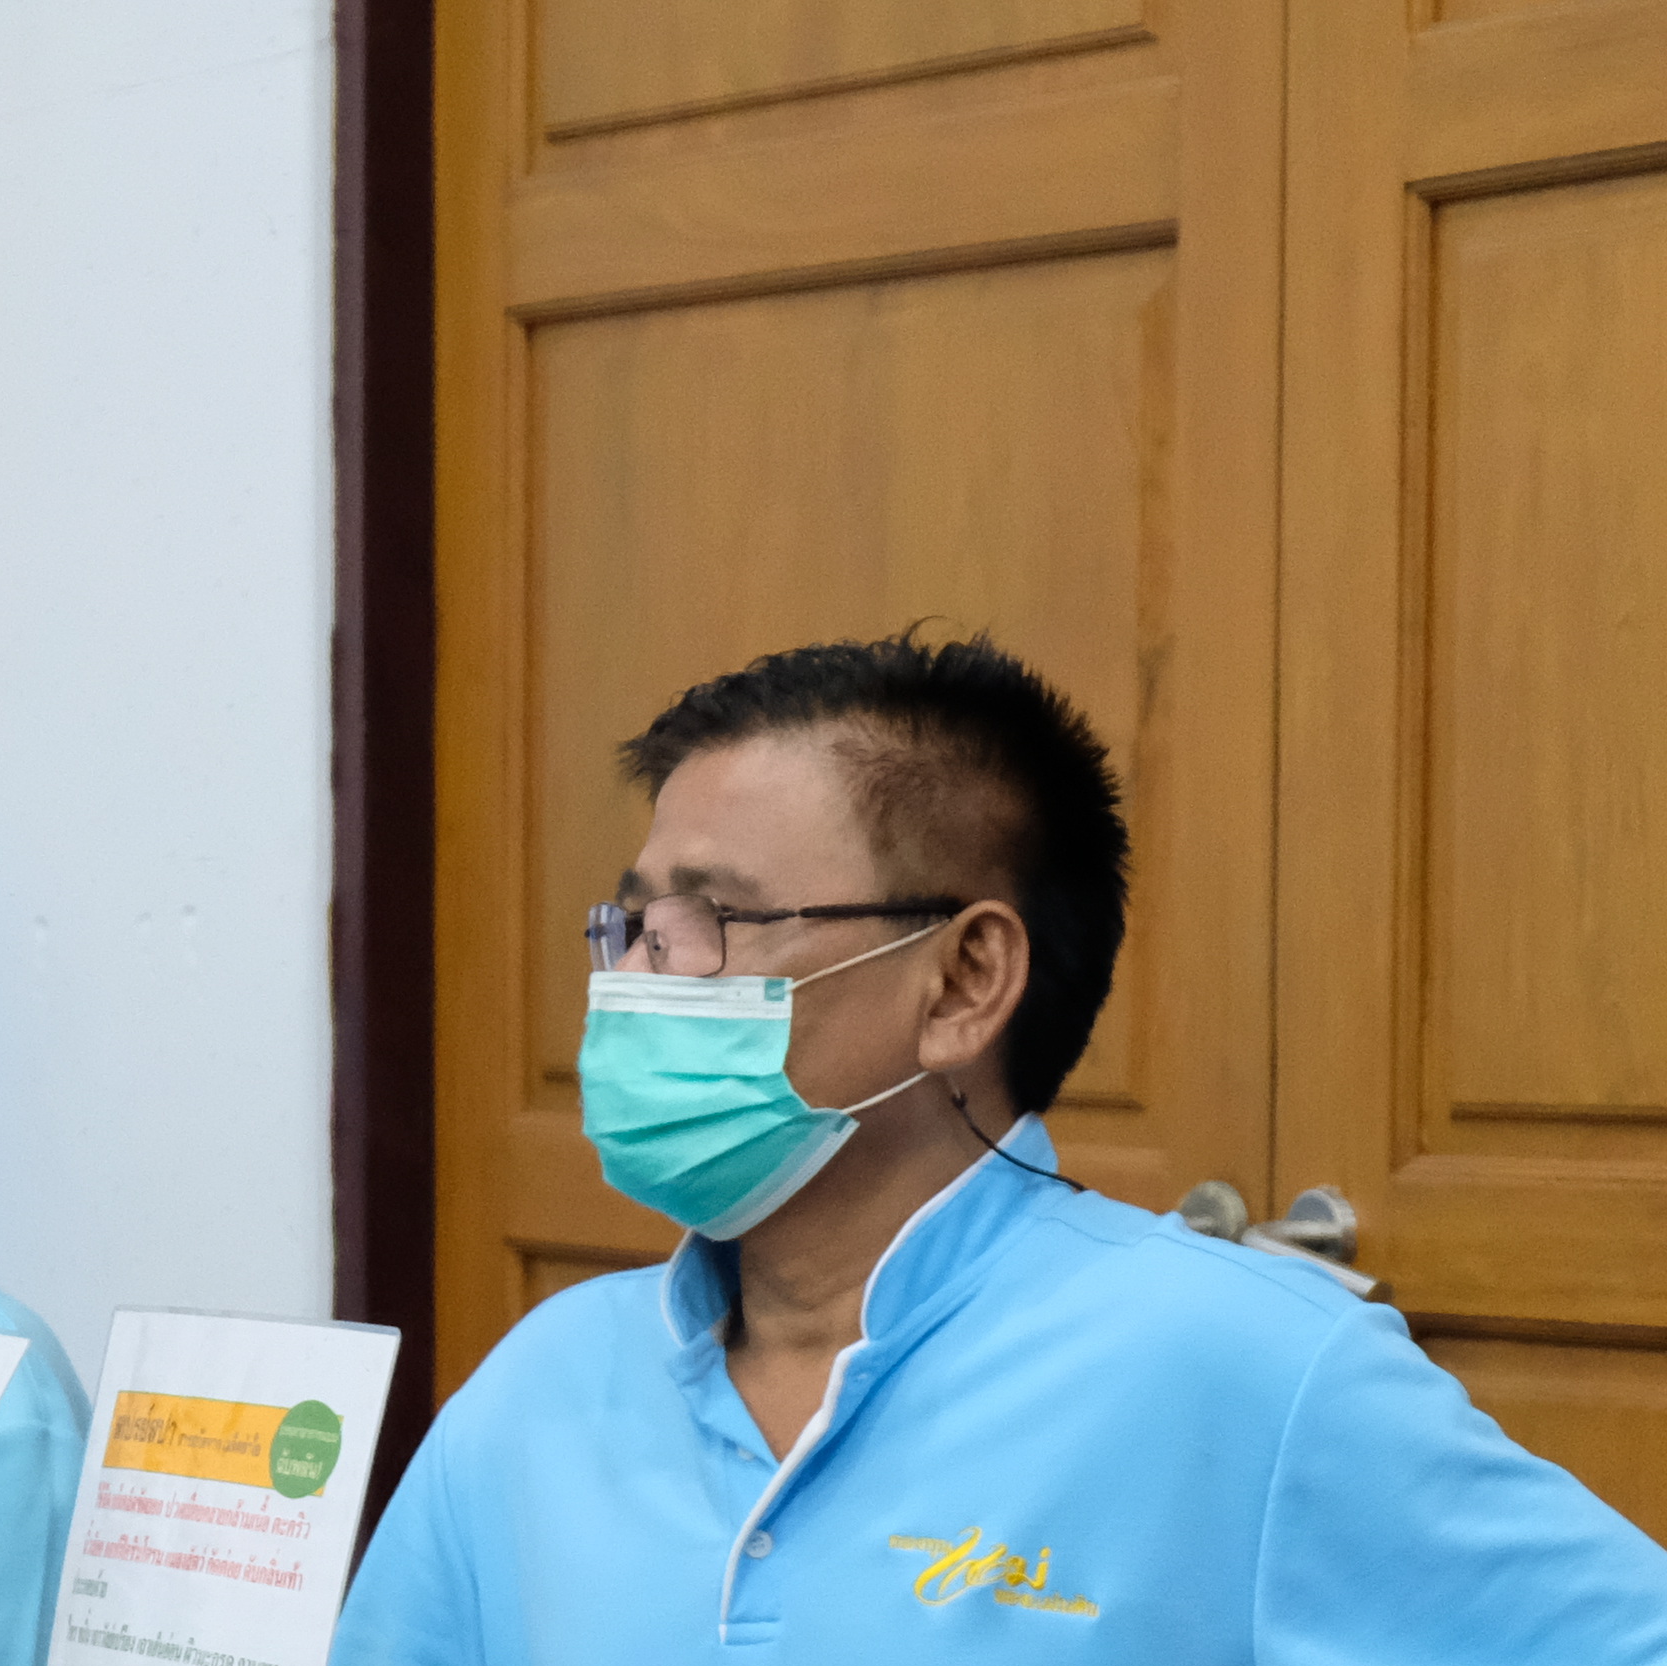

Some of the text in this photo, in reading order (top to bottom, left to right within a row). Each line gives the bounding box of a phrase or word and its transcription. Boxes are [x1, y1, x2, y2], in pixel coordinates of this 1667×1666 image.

[242, 1556, 304, 1591] ดับกลิ่นเท้า
